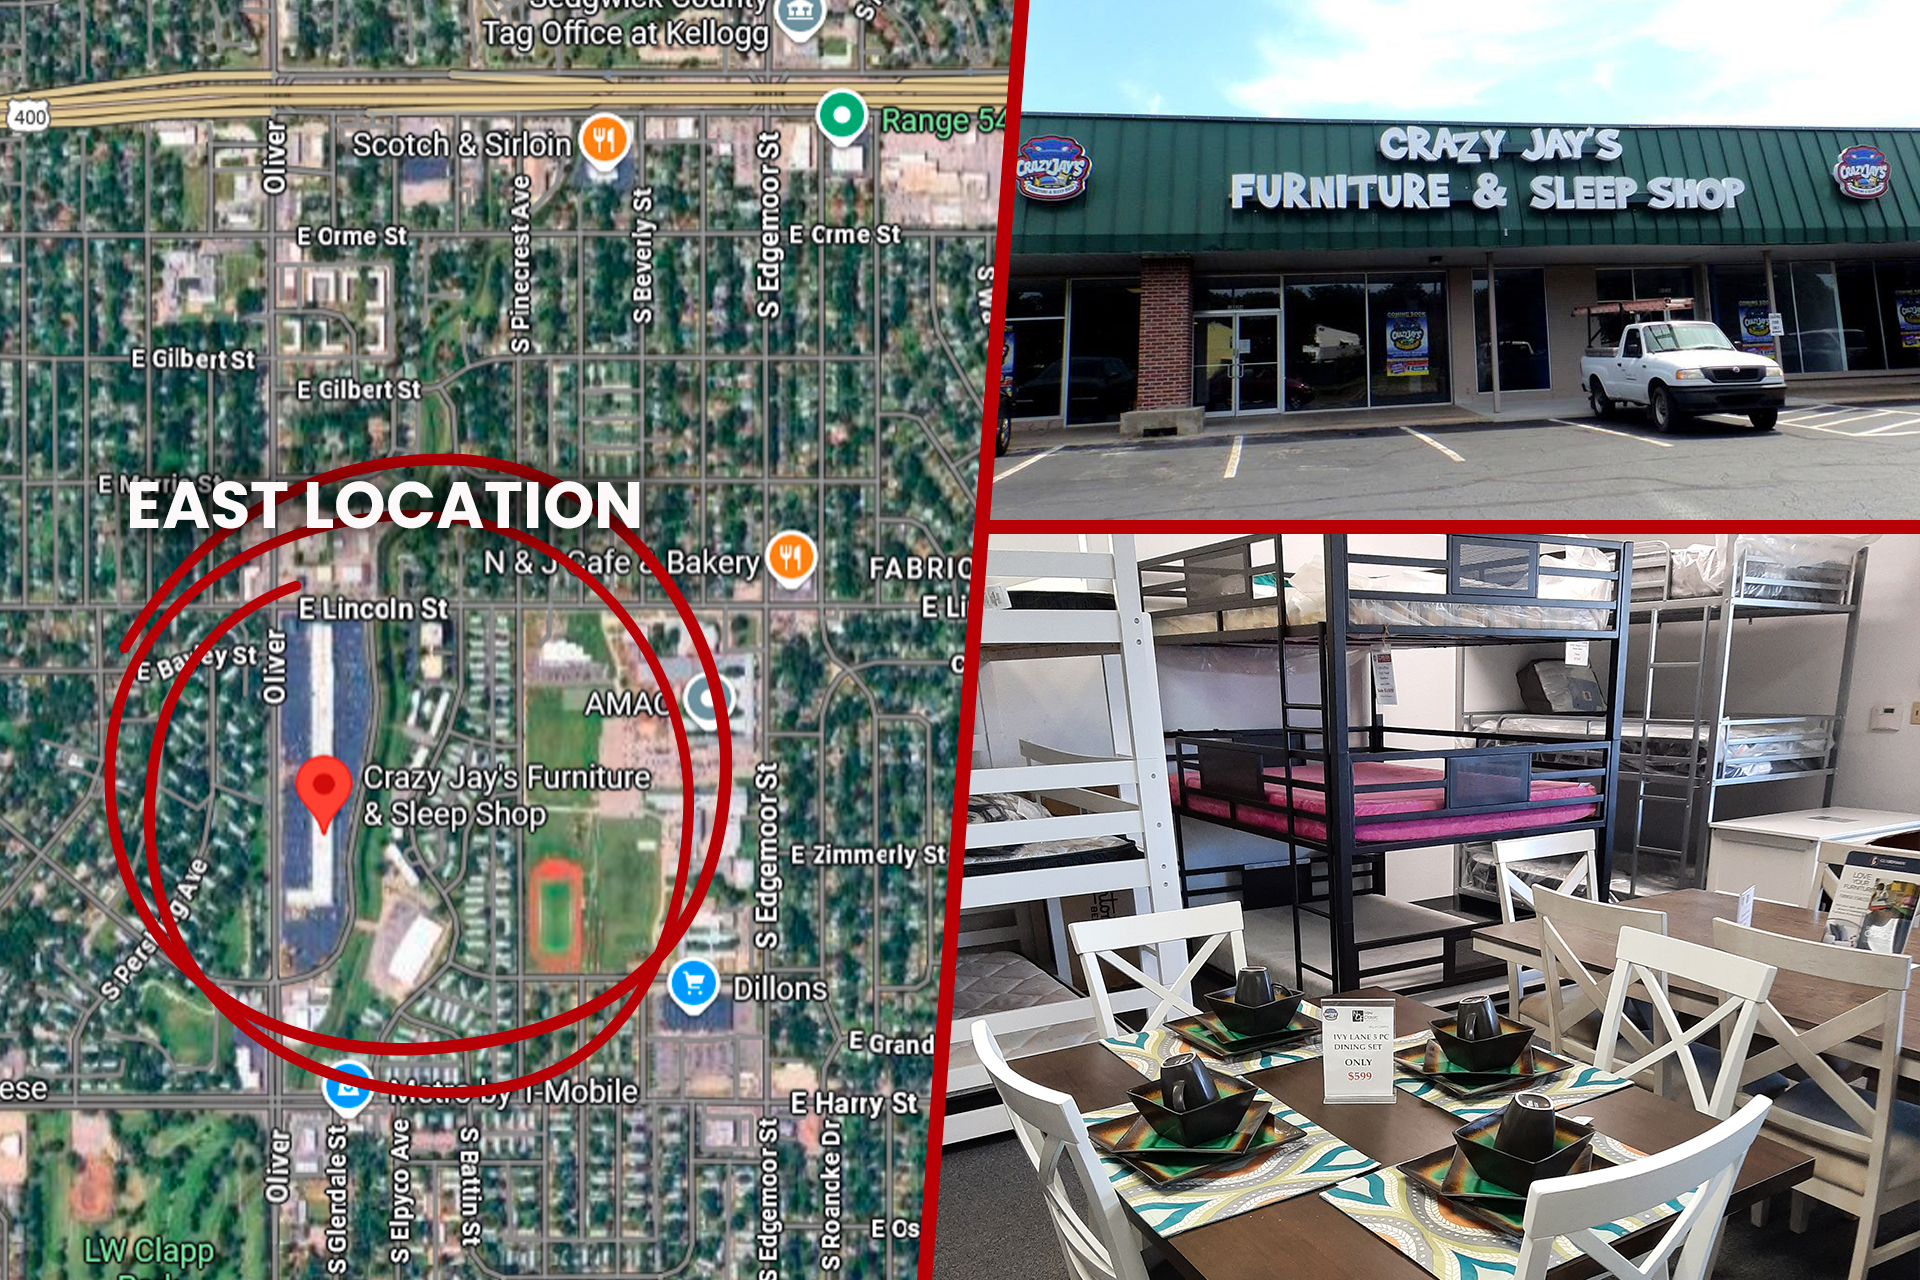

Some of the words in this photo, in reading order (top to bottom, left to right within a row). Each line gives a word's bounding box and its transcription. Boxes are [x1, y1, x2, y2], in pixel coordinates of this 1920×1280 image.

[482, 21, 533, 51] Tag
[542, 20, 622, 45] Office
[631, 22, 657, 45] at
[667, 20, 769, 51] Kellogg
[14, 109, 47, 126] 400
[882, 107, 969, 139] Range
[978, 107, 1006, 132] 54
[353, 131, 449, 157] Scotch
[458, 132, 477, 157] &
[485, 131, 571, 157] Sirloin
[757, 132, 779, 160] St
[1380, 126, 1506, 164] CRAZY
[1520, 126, 1623, 162] JAY'S
[263, 120, 287, 195] Oliver
[511, 174, 530, 219] Ave
[633, 188, 652, 211] St
[1231, 171, 1450, 210] FURNITURE
[1472, 172, 1508, 210] &
[1529, 175, 1638, 210] SLEEP
[1646, 176, 1745, 211] SHOP
[298, 227, 311, 245] E
[318, 227, 377, 245] Orme
[385, 227, 407, 245] St
[757, 177, 784, 291] Edgemoor
[790, 225, 803, 244] E
[877, 225, 900, 244] St
[633, 219, 657, 301] Beverly
[511, 224, 530, 329] Pinecrest
[633, 309, 652, 323] S
[758, 301, 779, 318] S
[511, 338, 530, 353] S
[132, 349, 145, 368] E
[153, 348, 227, 369] Gilbert
[231, 351, 256, 369] St
[298, 380, 311, 399] E
[319, 379, 393, 399] Gilbert
[398, 380, 421, 399] St
[99, 475, 112, 494] E
[485, 550, 504, 574] N
[514, 550, 532, 574] &
[668, 549, 760, 581] Bakery
[300, 597, 315, 619] E
[323, 596, 413, 619] Lincoln
[421, 597, 448, 619] St
[922, 595, 938, 618] E
[137, 661, 151, 681] E
[232, 645, 257, 665] St
[263, 629, 286, 704] Oliver
[364, 764, 441, 796] Crazy
[449, 764, 518, 796] Jay's
[527, 765, 651, 789] Furniture
[756, 763, 777, 789] St
[364, 801, 382, 825] &
[391, 800, 468, 832] Sleep
[476, 800, 547, 832] Shop
[755, 793, 783, 922] Edgemoor
[792, 845, 804, 864] E
[813, 844, 918, 869] Zimmerly
[924, 845, 946, 864] St
[100, 981, 121, 1001] S
[176, 859, 208, 901] Ave
[755, 932, 777, 948] S
[735, 975, 827, 1000] Dillons
[849, 1031, 863, 1050] E
[868, 1034, 934, 1055] Grand
[1379, 1033, 1390, 1041] PC
[1344, 1058, 1373, 1067] ONLY
[1348, 1071, 1372, 1081] $599
[0, 1081, 47, 1100] ese
[792, 1092, 807, 1114] E
[816, 1092, 884, 1119] Harry
[891, 1091, 917, 1114] St
[328, 1125, 346, 1149] St
[390, 1119, 409, 1161] Ave
[460, 1127, 479, 1142] S
[758, 1118, 778, 1143] St
[821, 1119, 841, 1146] Dr
[266, 1128, 291, 1204] Oliver
[460, 1151, 482, 1216] Battin
[326, 1154, 346, 1252] Glendale
[389, 1169, 414, 1240] Elpyco
[757, 1147, 783, 1261] Edgemoor
[462, 1221, 480, 1246] St
[872, 1219, 885, 1238] E
[85, 1238, 126, 1262] LW
[134, 1236, 214, 1269] Clapp
[390, 1248, 409, 1263] S
[821, 1255, 840, 1270] S
[328, 1259, 346, 1274] S
